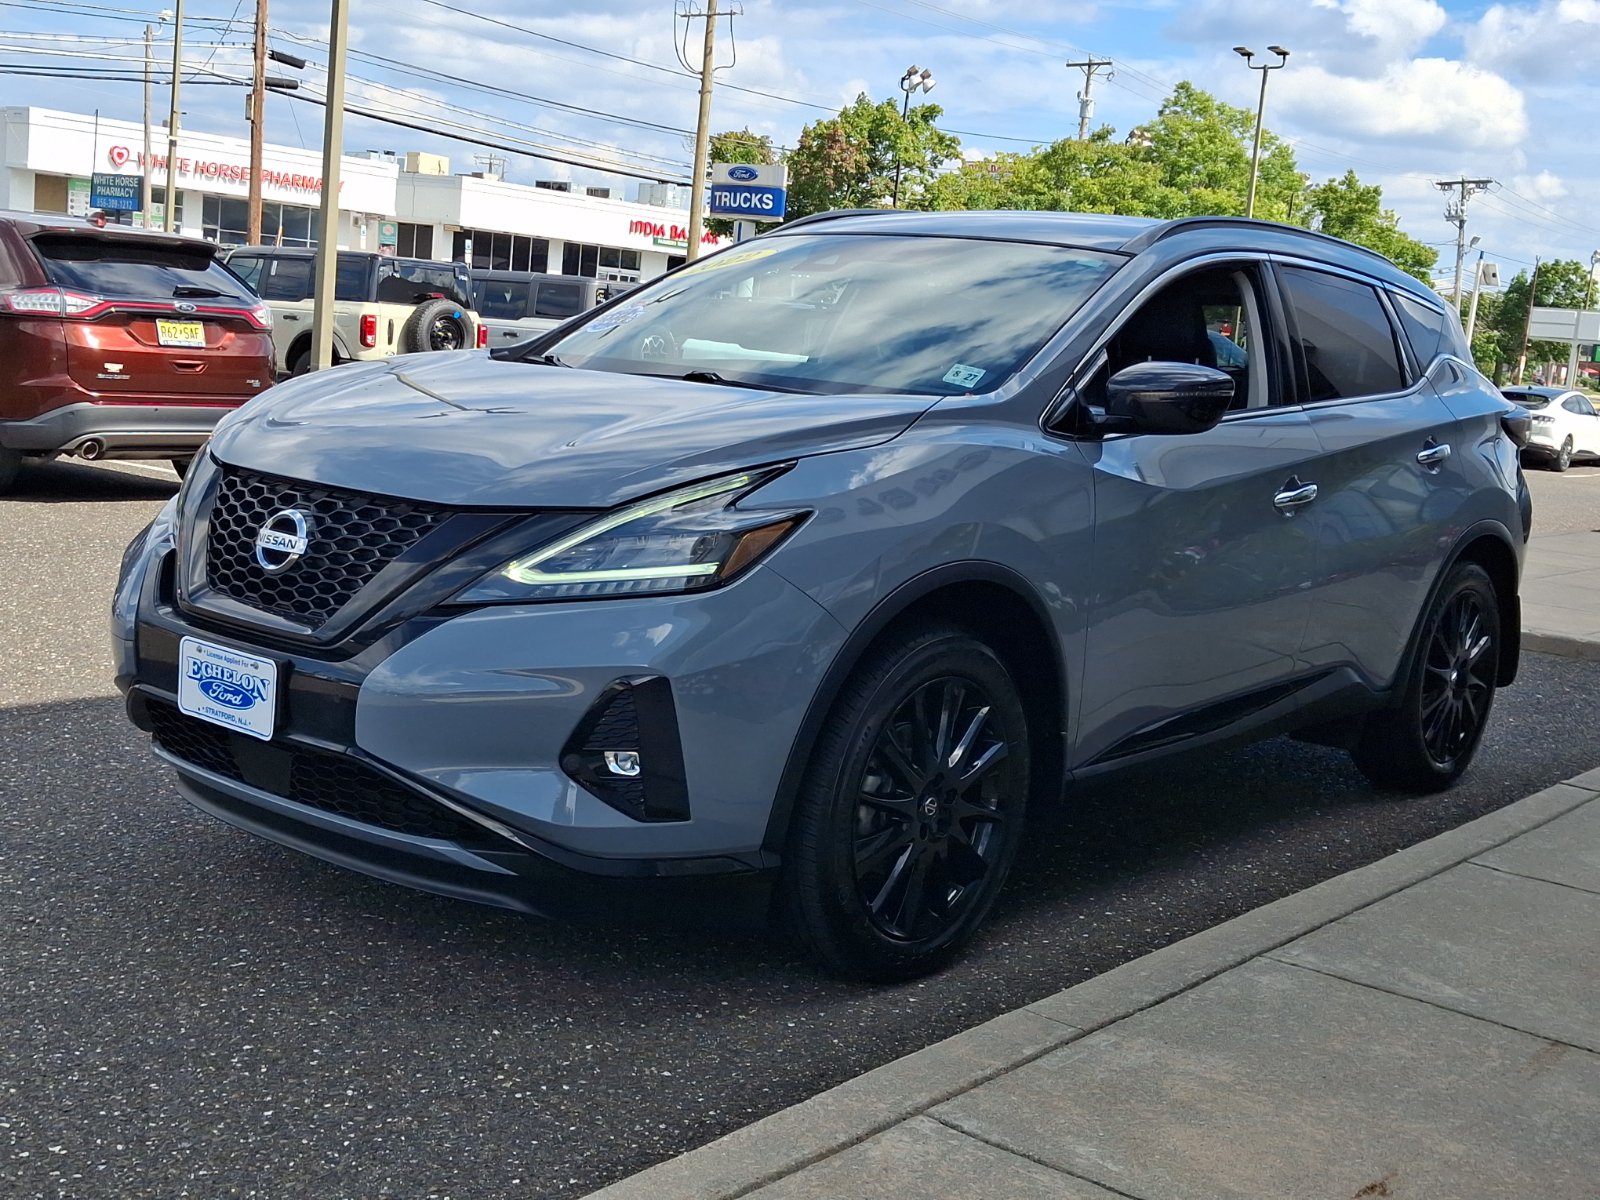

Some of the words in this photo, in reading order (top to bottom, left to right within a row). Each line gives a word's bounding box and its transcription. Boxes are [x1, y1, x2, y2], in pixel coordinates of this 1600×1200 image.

[93, 175, 115, 186] WHITE
[115, 176, 139, 188] HORSE
[137, 151, 191, 173] WHE
[194, 160, 250, 181] HORSE
[260, 168, 345, 193] PHARMA
[96, 186, 134, 198] PHARMACY
[714, 191, 774, 210] TRUCKS
[629, 219, 666, 238] INDIA
[669, 224, 719, 245] BAAR
[963, 373, 978, 381] 27
[259, 532, 298, 550] NISSAN
[206, 649, 224, 661] License
[224, 654, 241, 666] Applied
[241, 659, 249, 668] For
[186, 655, 270, 702] ECHELON
[209, 682, 244, 705] Ford
